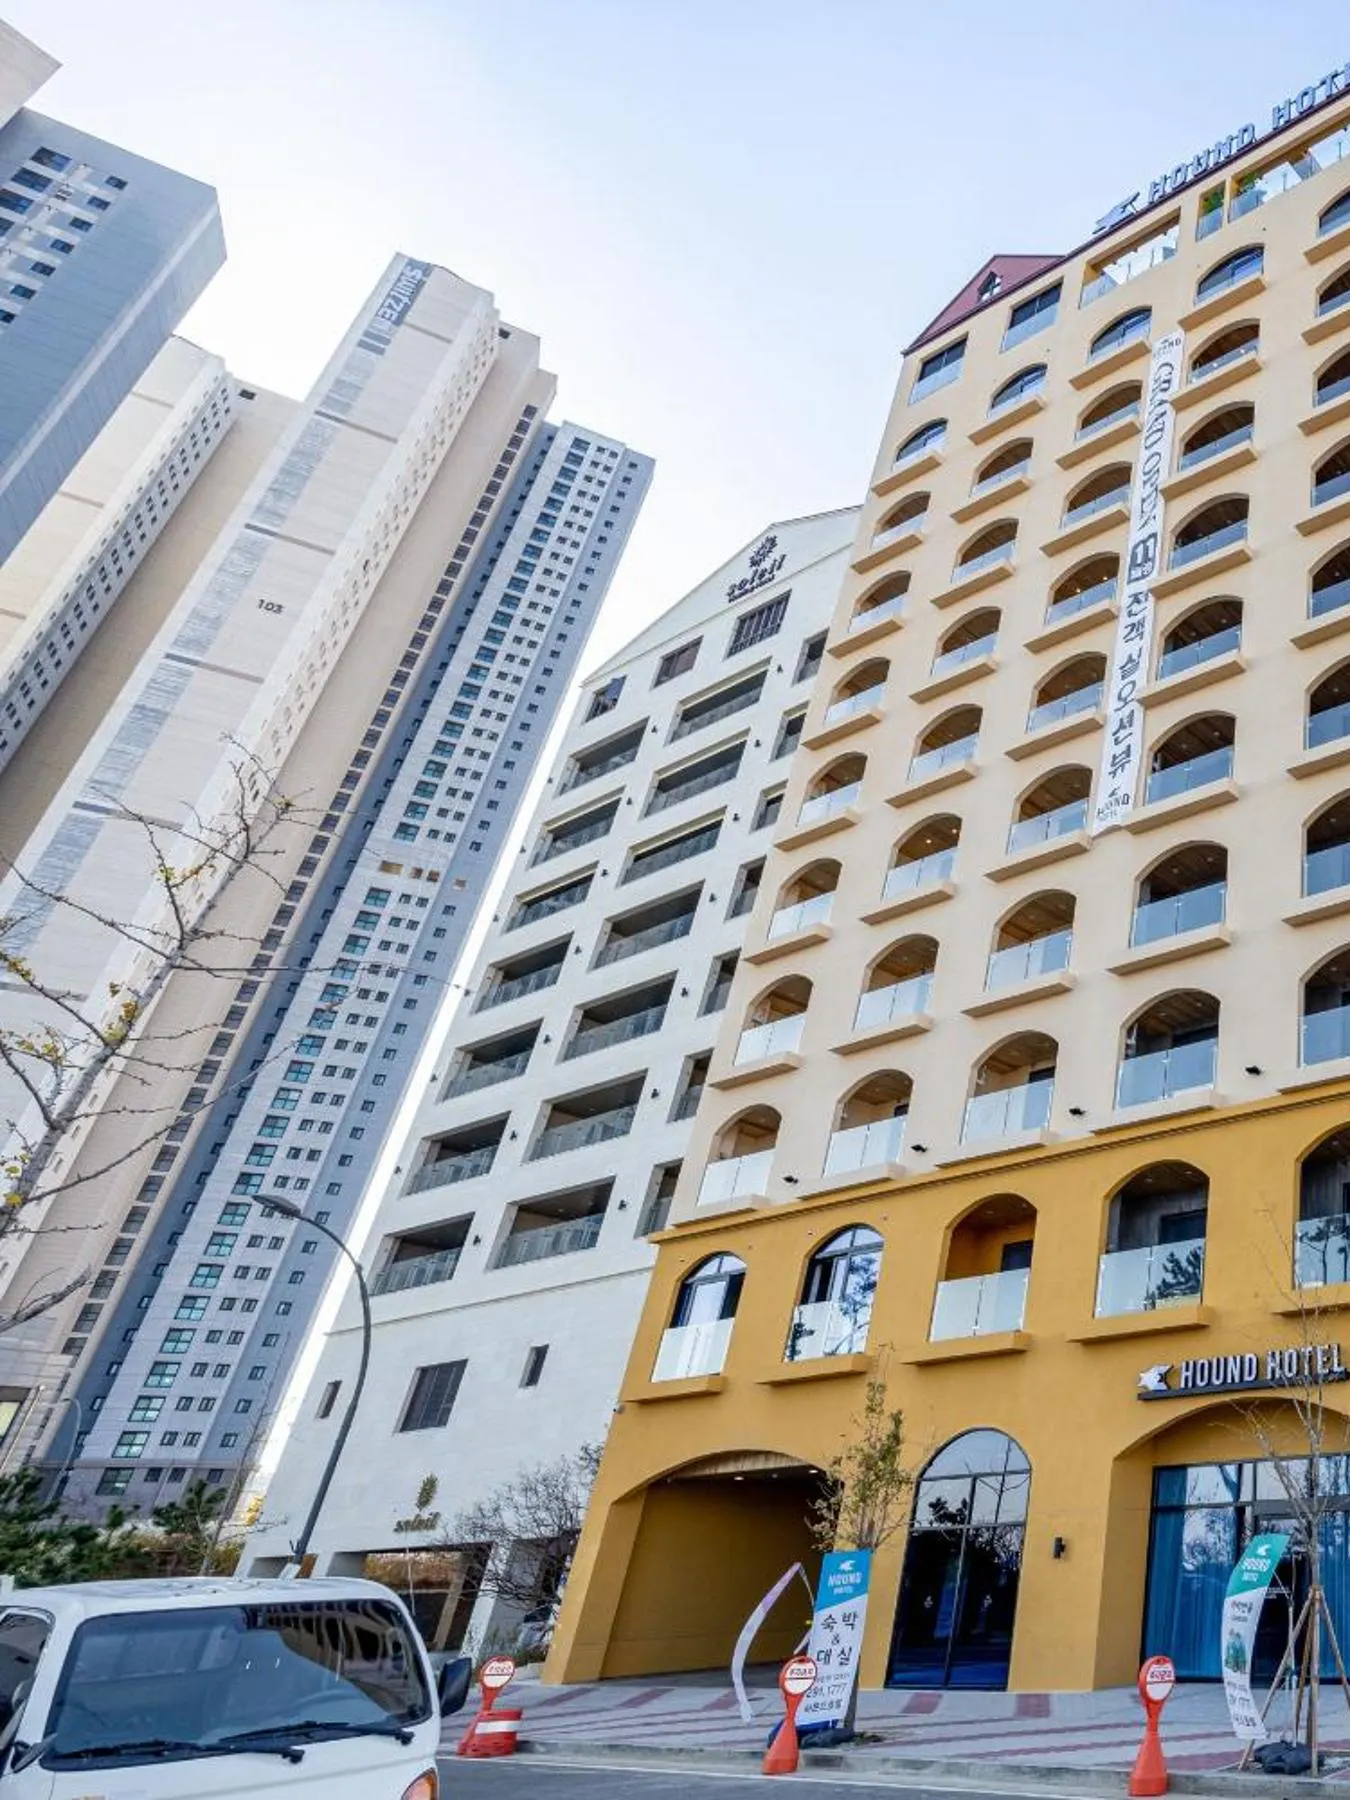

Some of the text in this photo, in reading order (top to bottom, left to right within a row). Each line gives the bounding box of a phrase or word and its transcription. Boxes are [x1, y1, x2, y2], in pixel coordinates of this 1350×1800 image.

[1147, 122, 1257, 207] HOUND
[1180, 1343, 1345, 1389] HOUND HOTEL
